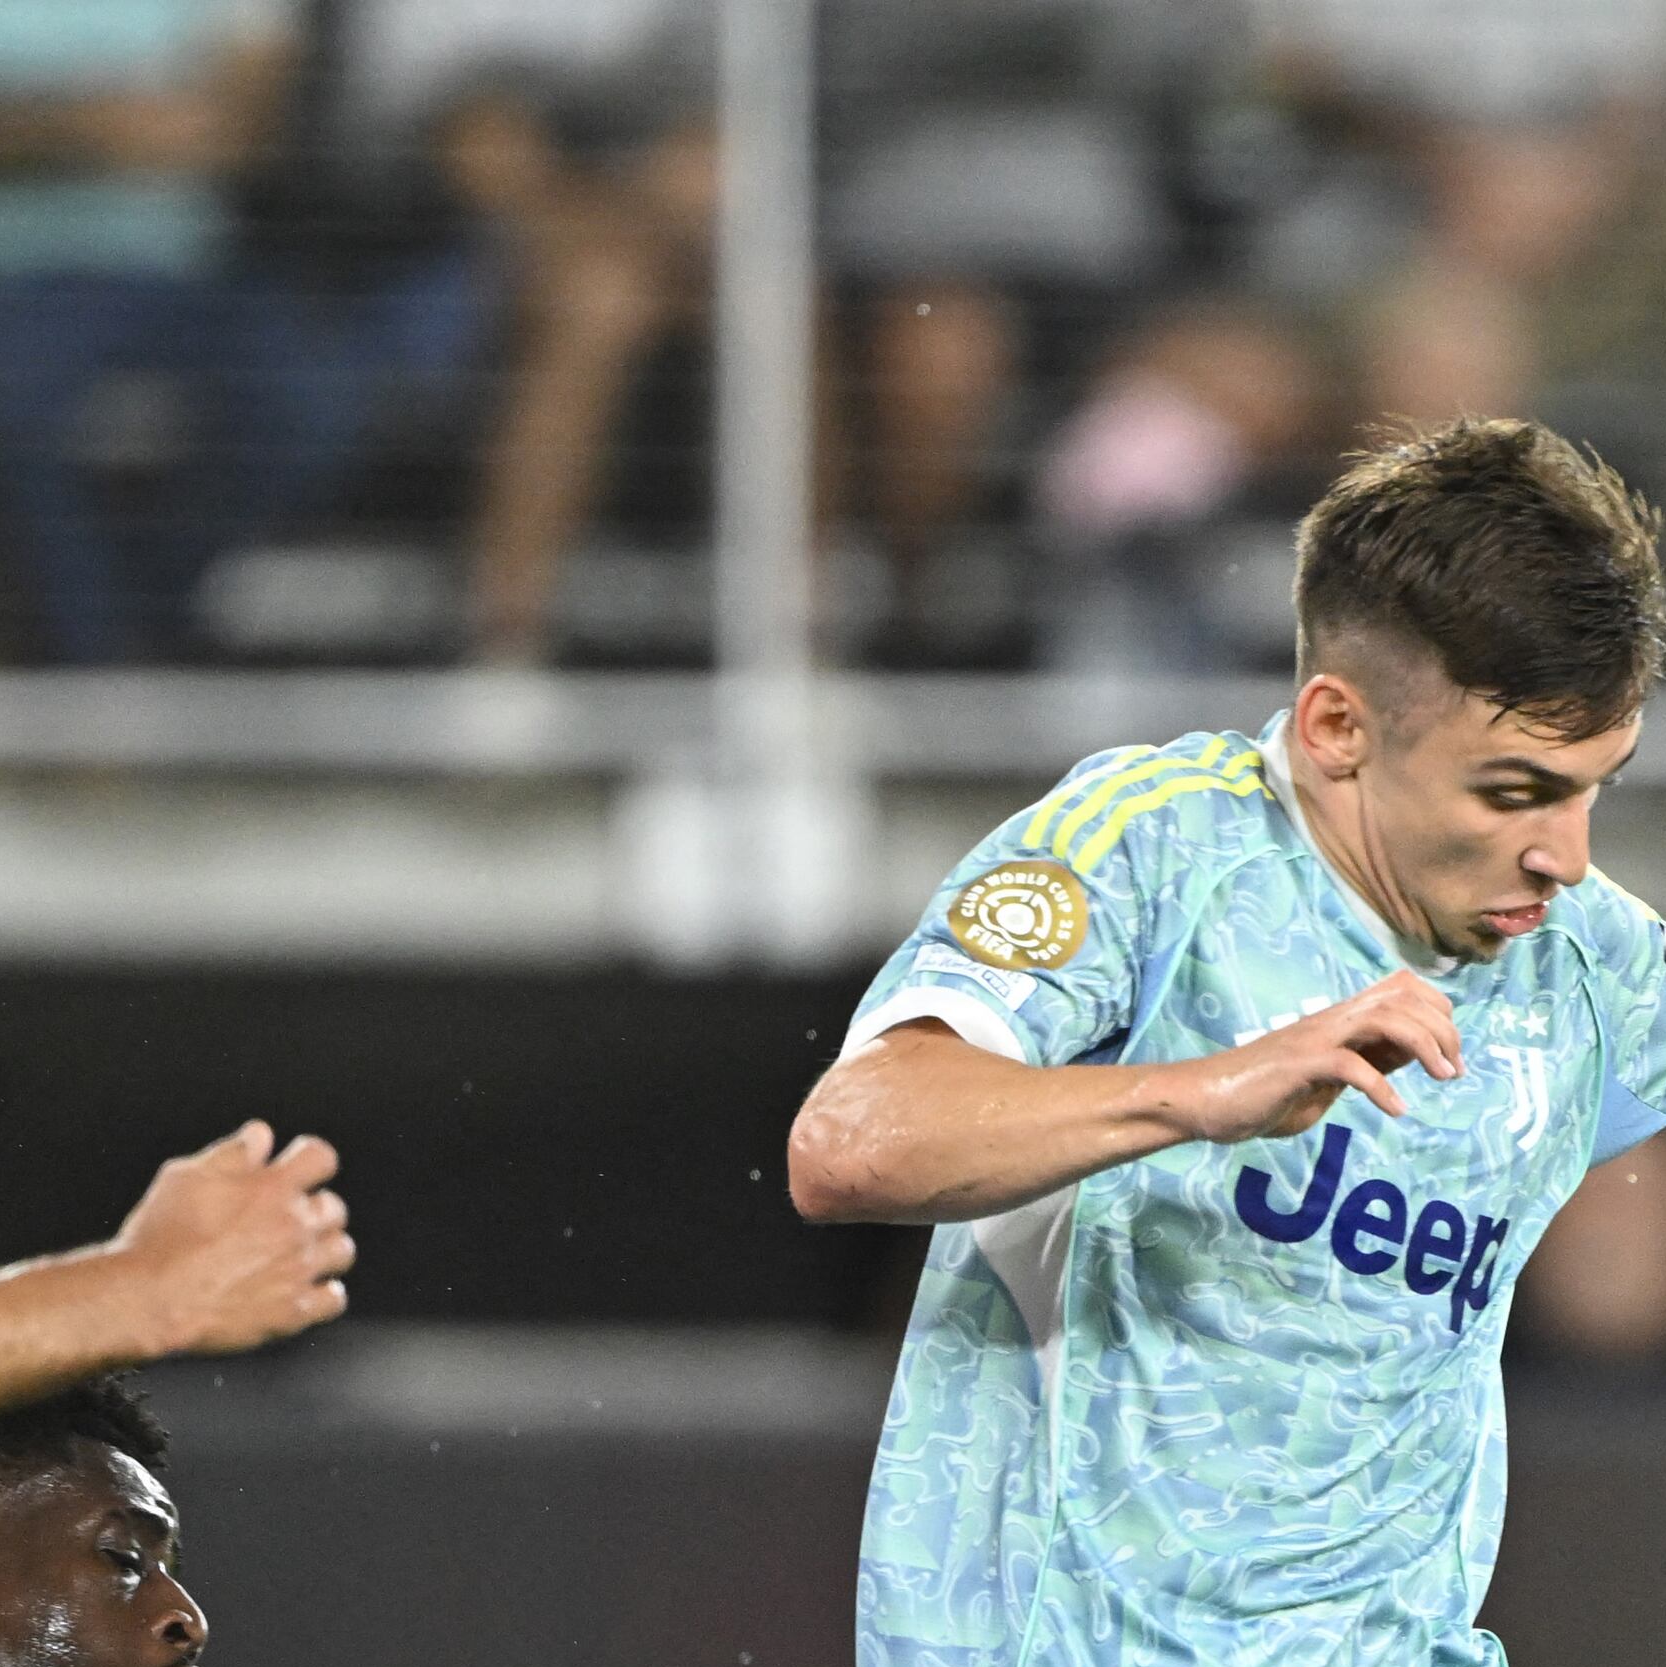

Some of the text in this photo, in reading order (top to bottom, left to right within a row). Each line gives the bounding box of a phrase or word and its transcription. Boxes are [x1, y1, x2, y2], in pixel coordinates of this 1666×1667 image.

[984, 872, 1049, 887] WORLD
[1048, 882, 1073, 912] CUP
[964, 923, 1019, 961] FIFA
[1234, 1122, 1509, 1335] Jeep
